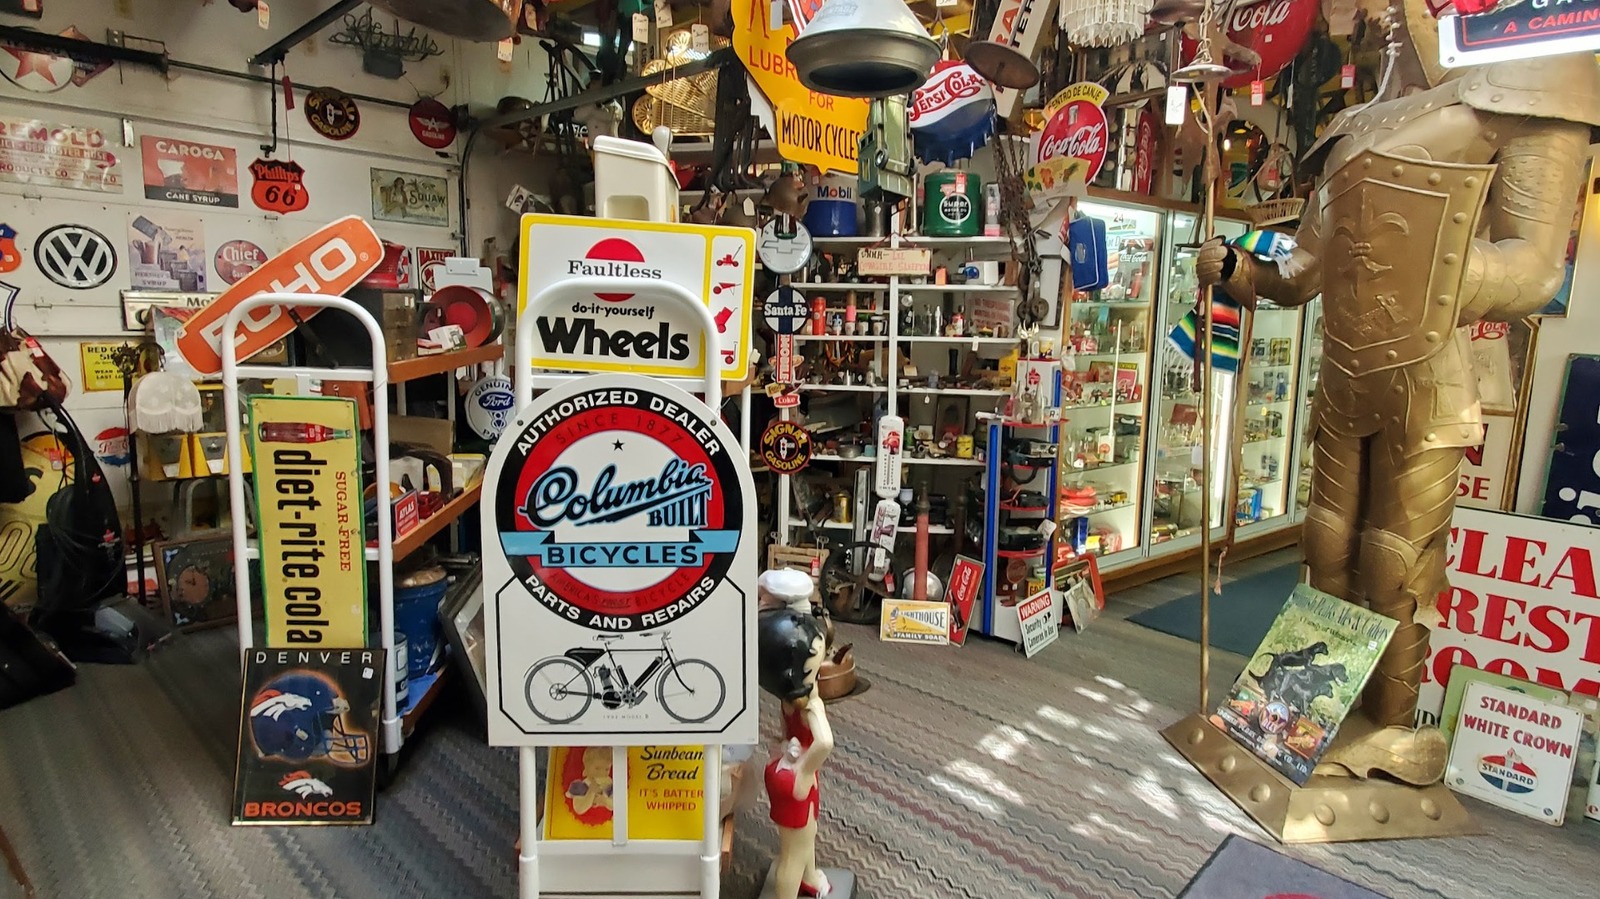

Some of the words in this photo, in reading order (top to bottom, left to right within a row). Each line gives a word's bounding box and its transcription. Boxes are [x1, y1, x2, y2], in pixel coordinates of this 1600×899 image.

[1504, 21, 1517, 34] A
[809, 91, 834, 111] FOR
[311, 113, 355, 136] GASOLINE
[782, 110, 822, 153] MOTOR
[1042, 122, 1104, 158] Coca-Cola
[156, 141, 225, 161] CAROGA
[255, 164, 300, 183] Phillips
[166, 191, 189, 201] CANE
[192, 194, 221, 204] SYRUP
[265, 185, 295, 206] 66
[817, 186, 852, 199] Mobil
[223, 246, 260, 262] Chief
[567, 260, 662, 279] Faultless
[571, 302, 655, 319] do-it-yourself
[764, 304, 793, 316] Santa
[795, 304, 808, 316] Fe
[536, 316, 690, 361] Wheels
[482, 395, 511, 408] Ford
[778, 396, 796, 404] Coke
[516, 390, 639, 457] AUTHORIZED
[649, 395, 720, 456] DEALER
[556, 413, 619, 444] SINCE
[635, 415, 684, 443] 1877
[763, 424, 808, 448] SIGNAL
[765, 449, 806, 470] GASOLINE
[519, 457, 712, 527] Columbia
[273, 450, 328, 578] diet-rite
[399, 501, 415, 520] ATLAS
[647, 490, 711, 527] BUILT
[547, 545, 698, 565] BICYCLES
[635, 572, 691, 607] BICYCLE
[525, 576, 581, 620] PARTS
[589, 615, 632, 630] AND
[641, 576, 715, 626] REPAIRS
[1020, 594, 1050, 619] WARNING
[284, 586, 330, 644] cola
[256, 651, 373, 664] DENVER
[1480, 696, 1562, 730] STANDARD
[1463, 713, 1510, 740] WHITE
[1512, 729, 1573, 759] CROWN
[646, 763, 699, 781] Bread
[1482, 763, 1534, 786] STANDARD
[663, 789, 704, 799] BATTER
[244, 802, 361, 818] BRONCOS
[646, 802, 697, 811] WHIPPED
